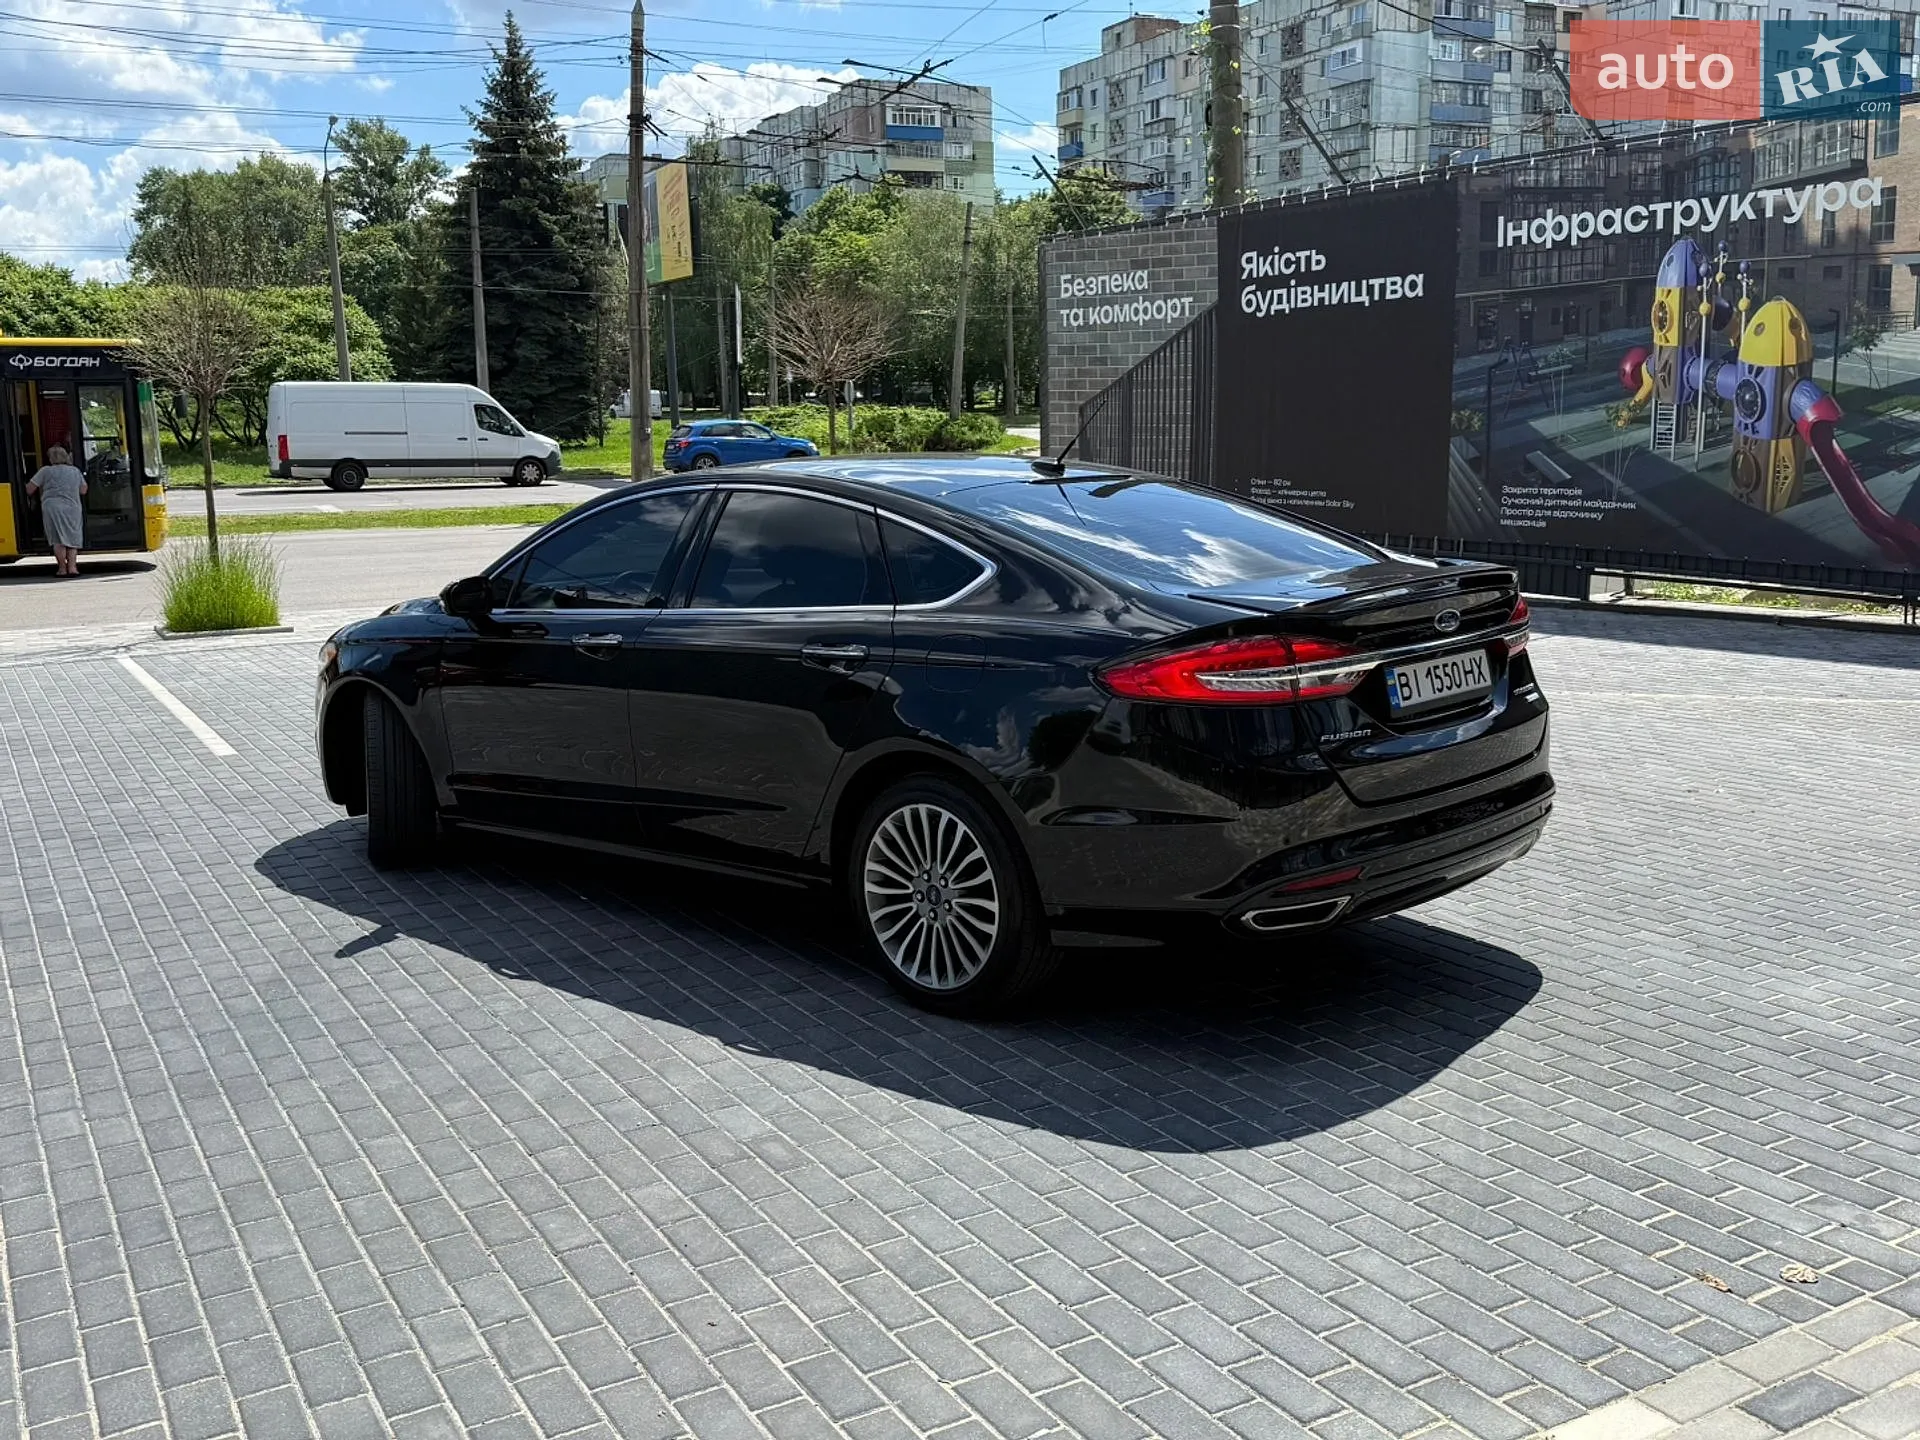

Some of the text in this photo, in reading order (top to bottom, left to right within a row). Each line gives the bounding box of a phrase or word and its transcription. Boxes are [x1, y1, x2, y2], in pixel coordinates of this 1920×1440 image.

[1497, 176, 1883, 249] Інфраструктура
[1241, 246, 1327, 280] Якість
[1060, 270, 1149, 298] Безпека
[1241, 273, 1425, 318] будівництва
[1060, 296, 1193, 327] та комфорт
[33, 356, 100, 367] БОГДАН
[1500, 506, 1535, 517] Простір
[1582, 499, 1637, 510] майданчик
[1425, 661, 1462, 695] 1550
[1319, 729, 1372, 743] FUSION
